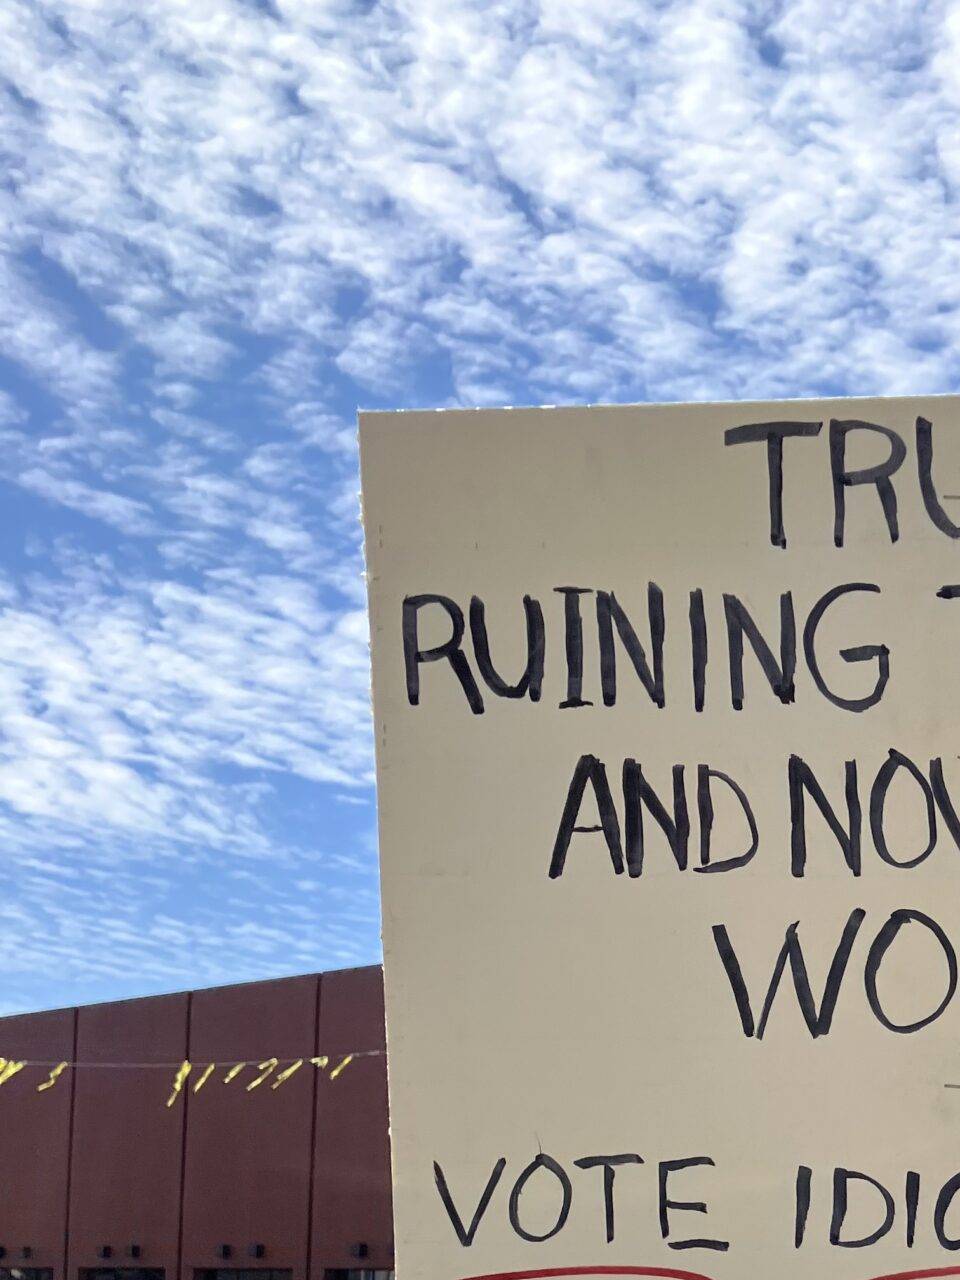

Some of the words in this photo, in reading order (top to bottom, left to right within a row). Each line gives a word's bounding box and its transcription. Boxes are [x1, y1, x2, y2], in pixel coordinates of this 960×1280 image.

[402, 582, 890, 715] RUINING
[549, 754, 758, 879] AND
[434, 1155, 729, 1251] VOTE
